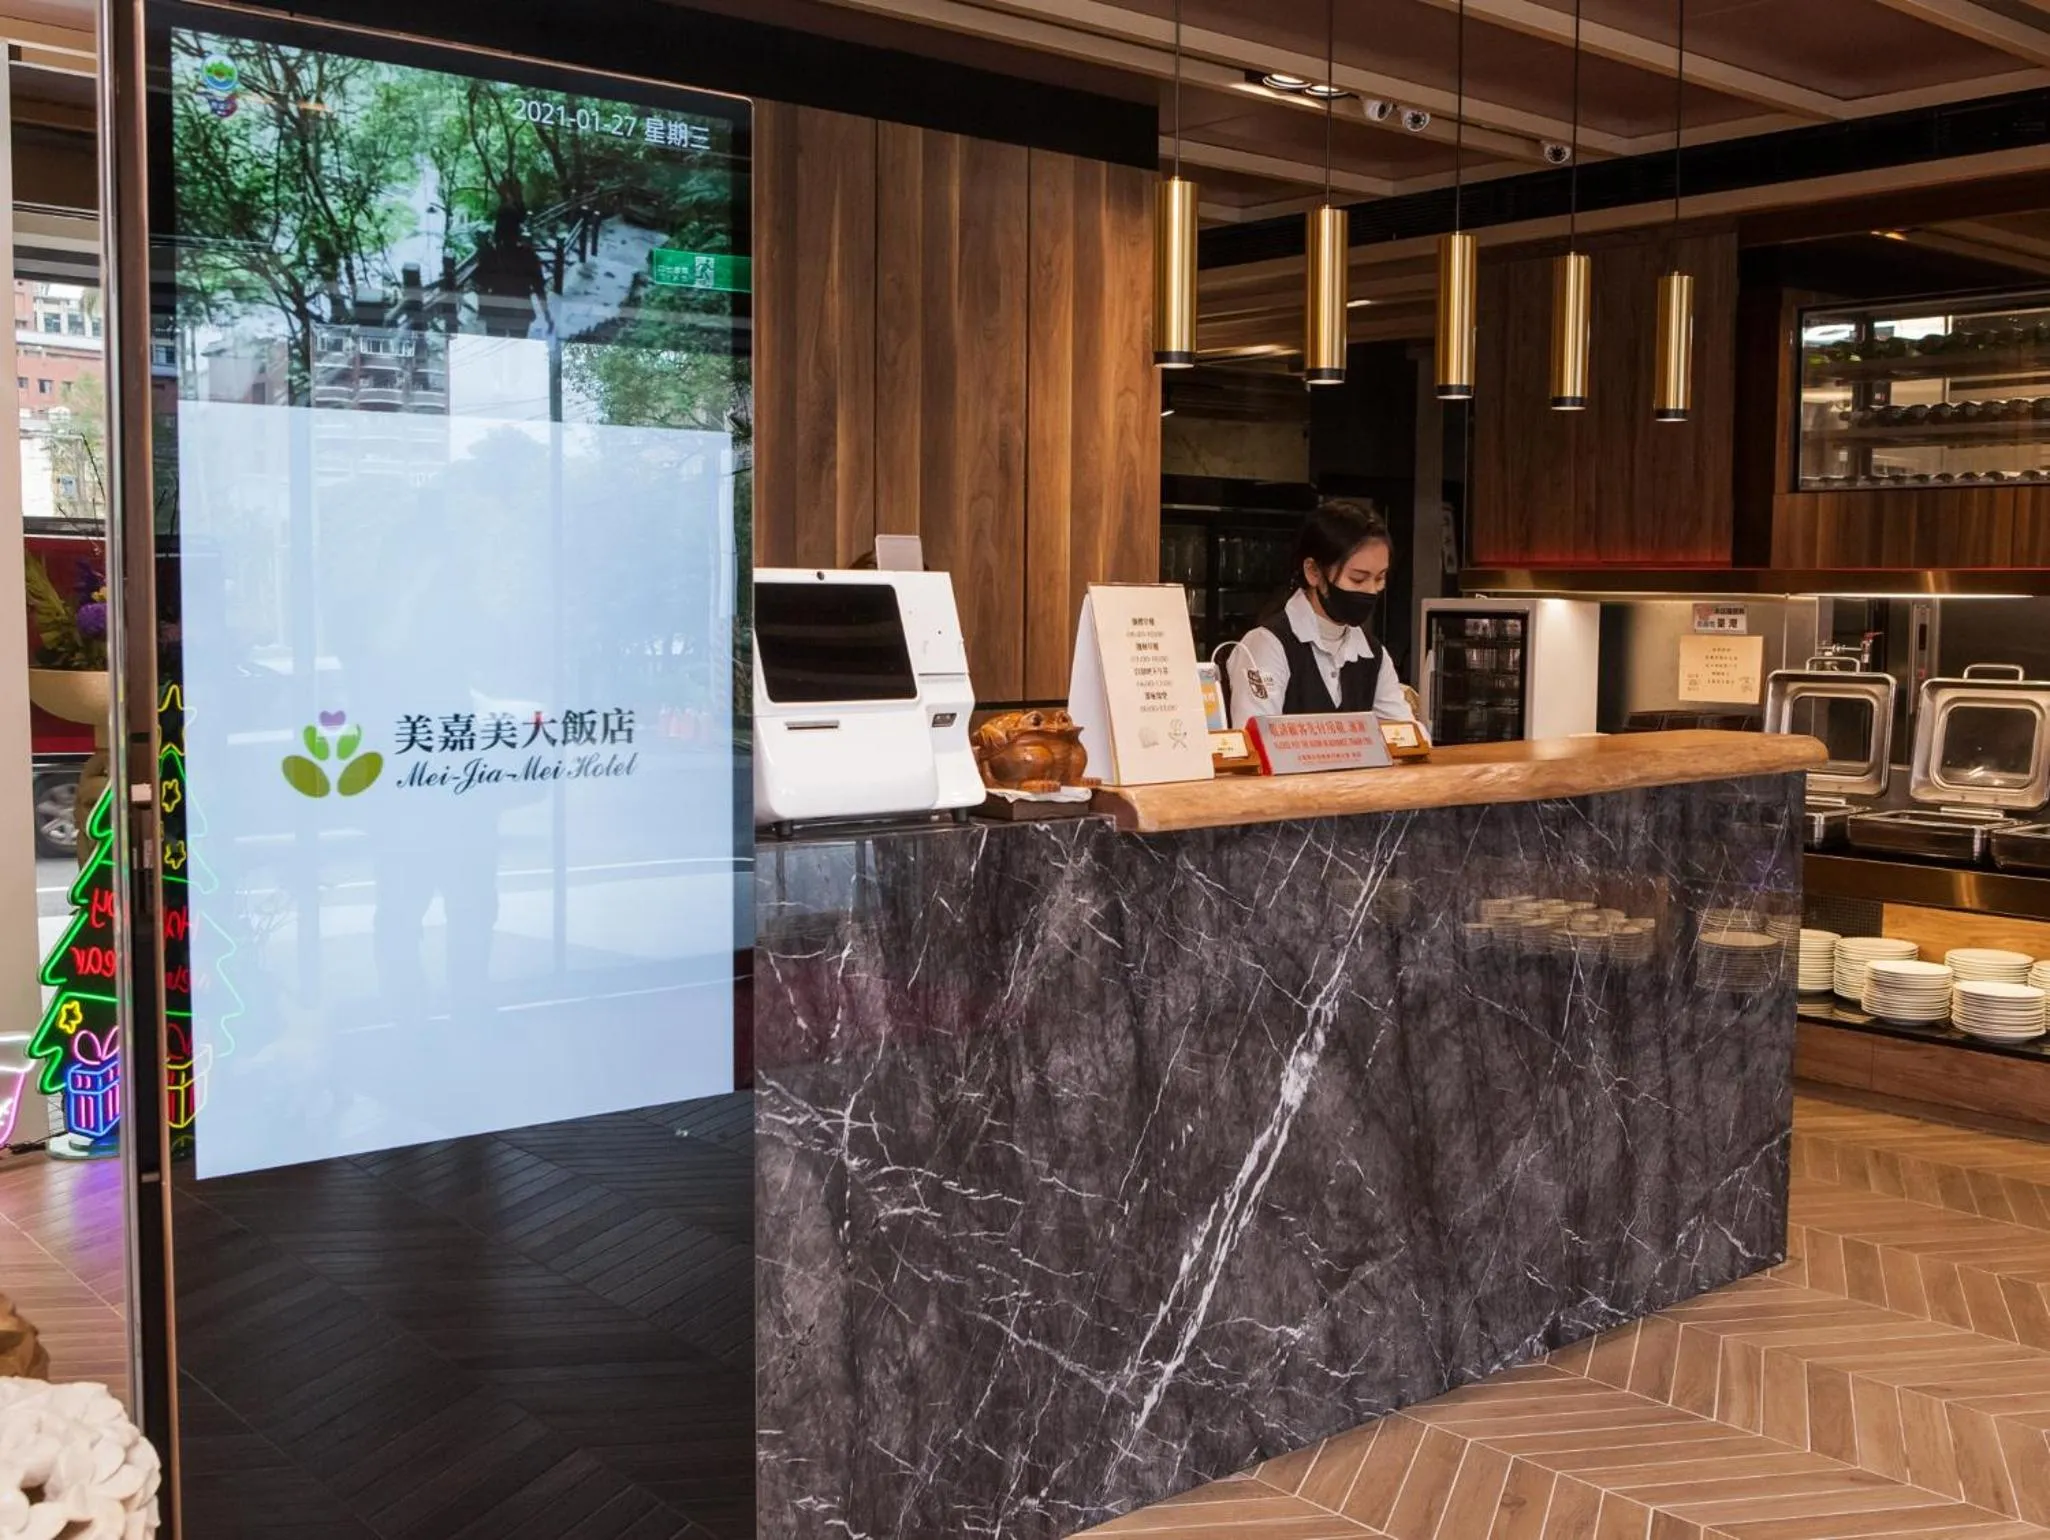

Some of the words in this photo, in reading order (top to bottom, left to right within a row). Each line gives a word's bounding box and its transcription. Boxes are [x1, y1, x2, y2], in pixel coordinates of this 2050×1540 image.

[513, 98, 637, 137] 2021-01-27
[644, 116, 711, 150] 星期三
[395, 706, 636, 754] 美嘉美大飯店
[567, 751, 640, 779] Hotel
